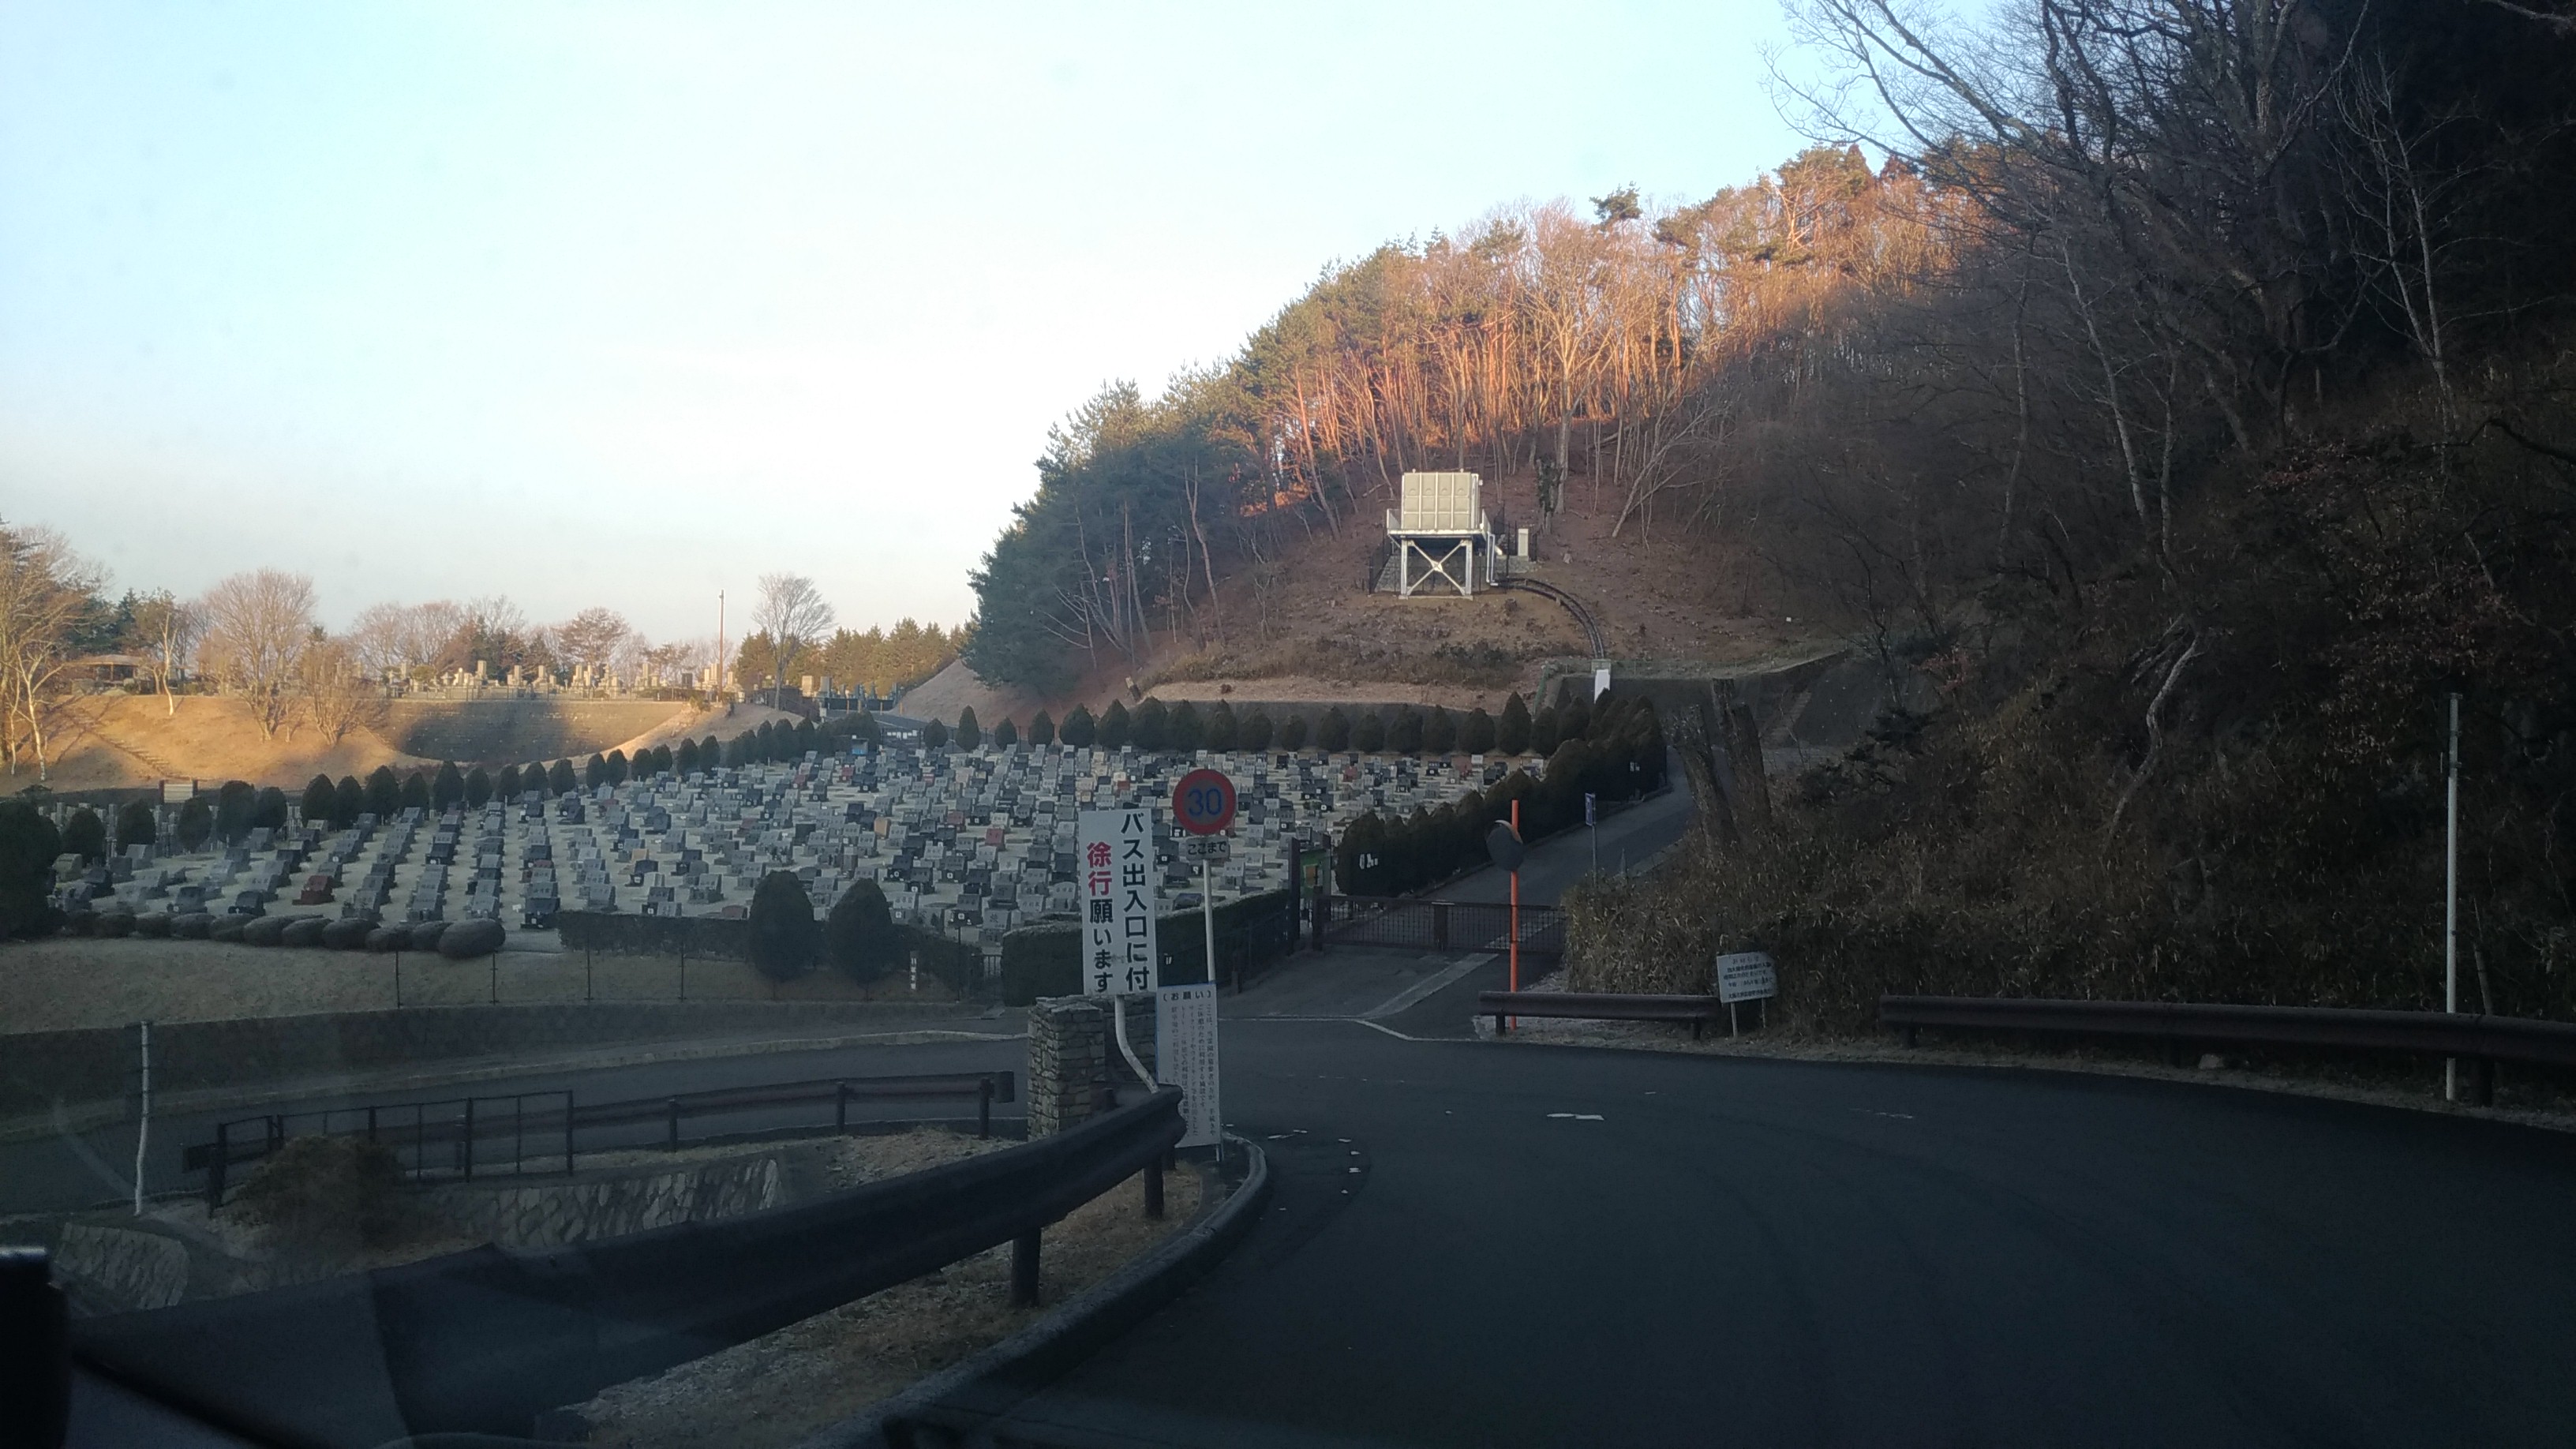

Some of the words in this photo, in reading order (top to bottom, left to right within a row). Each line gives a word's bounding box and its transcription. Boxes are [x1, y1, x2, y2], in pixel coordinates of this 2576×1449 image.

[1189, 788, 1222, 816] 30
[1188, 841, 1227, 856] ここまで
[1087, 841, 1114, 993] 徐行願います
[1121, 812, 1150, 992] バス出入口に付
